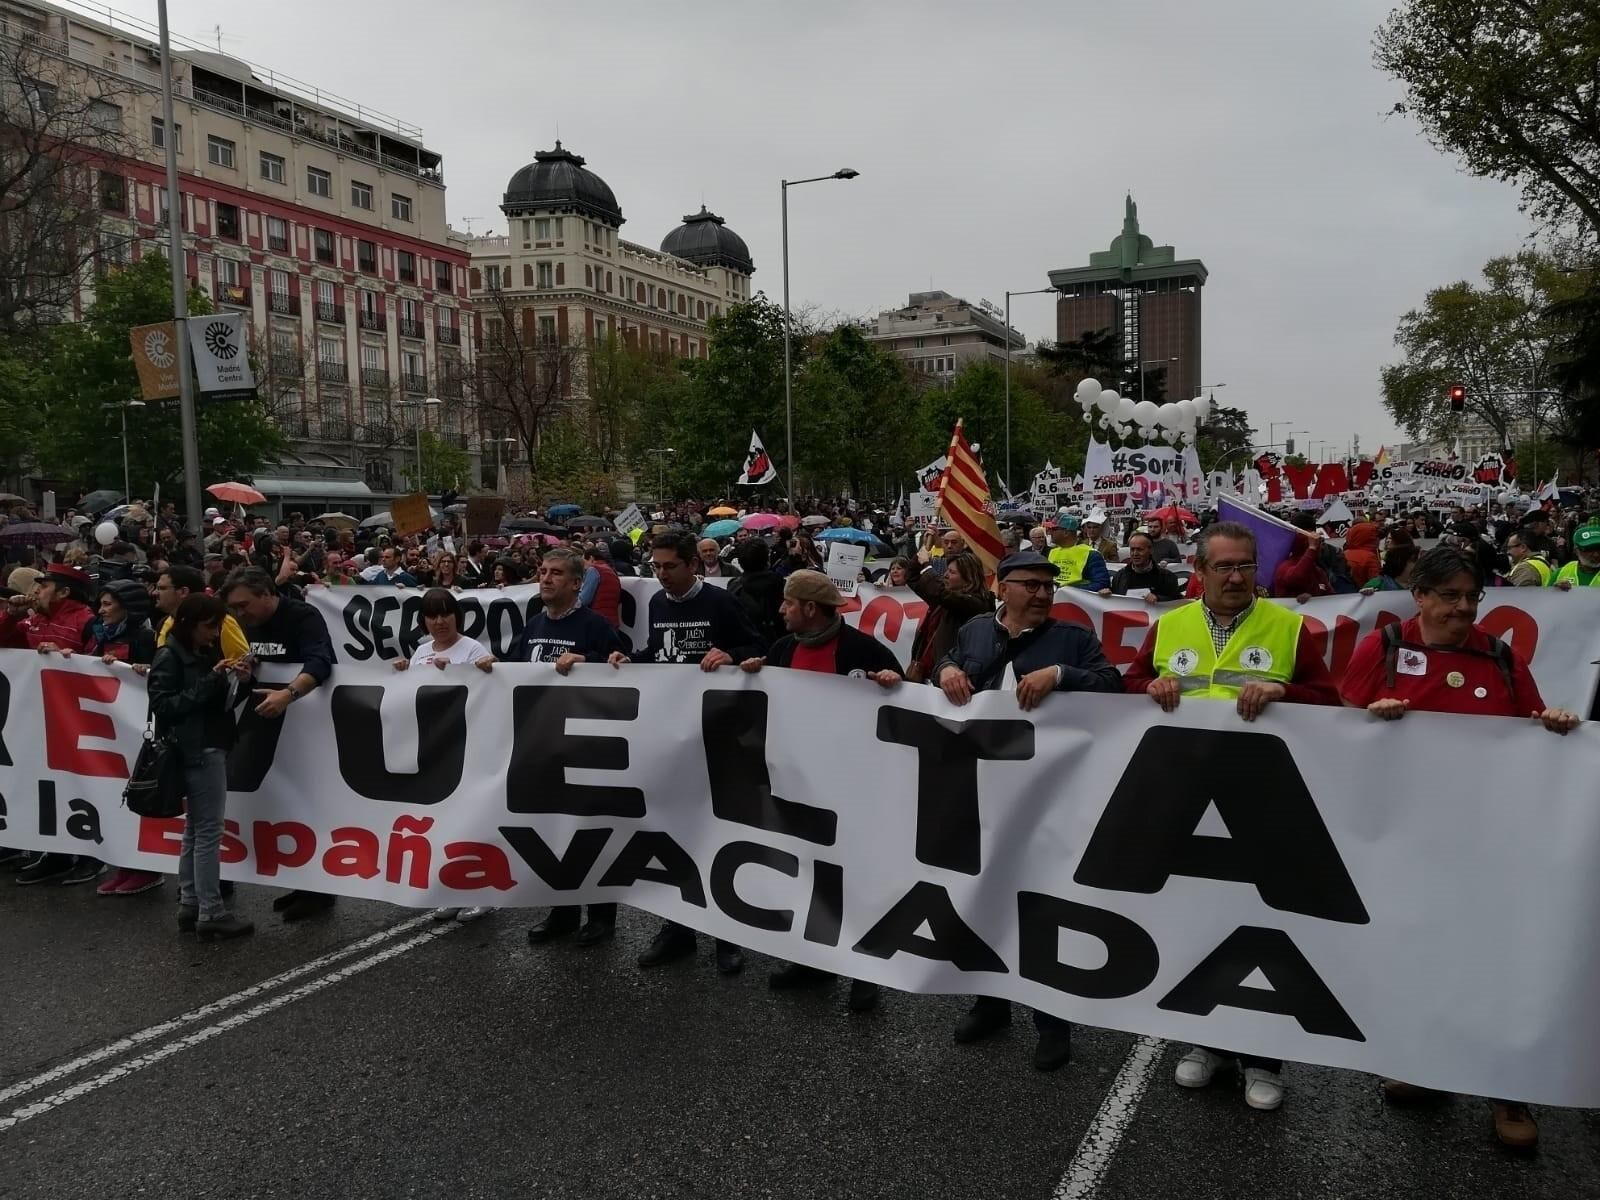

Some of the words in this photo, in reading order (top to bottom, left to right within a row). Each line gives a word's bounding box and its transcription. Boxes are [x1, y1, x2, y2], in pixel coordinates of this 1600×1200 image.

[1112, 453, 1185, 475] #Sori
[1038, 483, 1057, 494] 8,6
[39, 780, 104, 844] la
[498, 826, 1367, 1043] VACIADA
